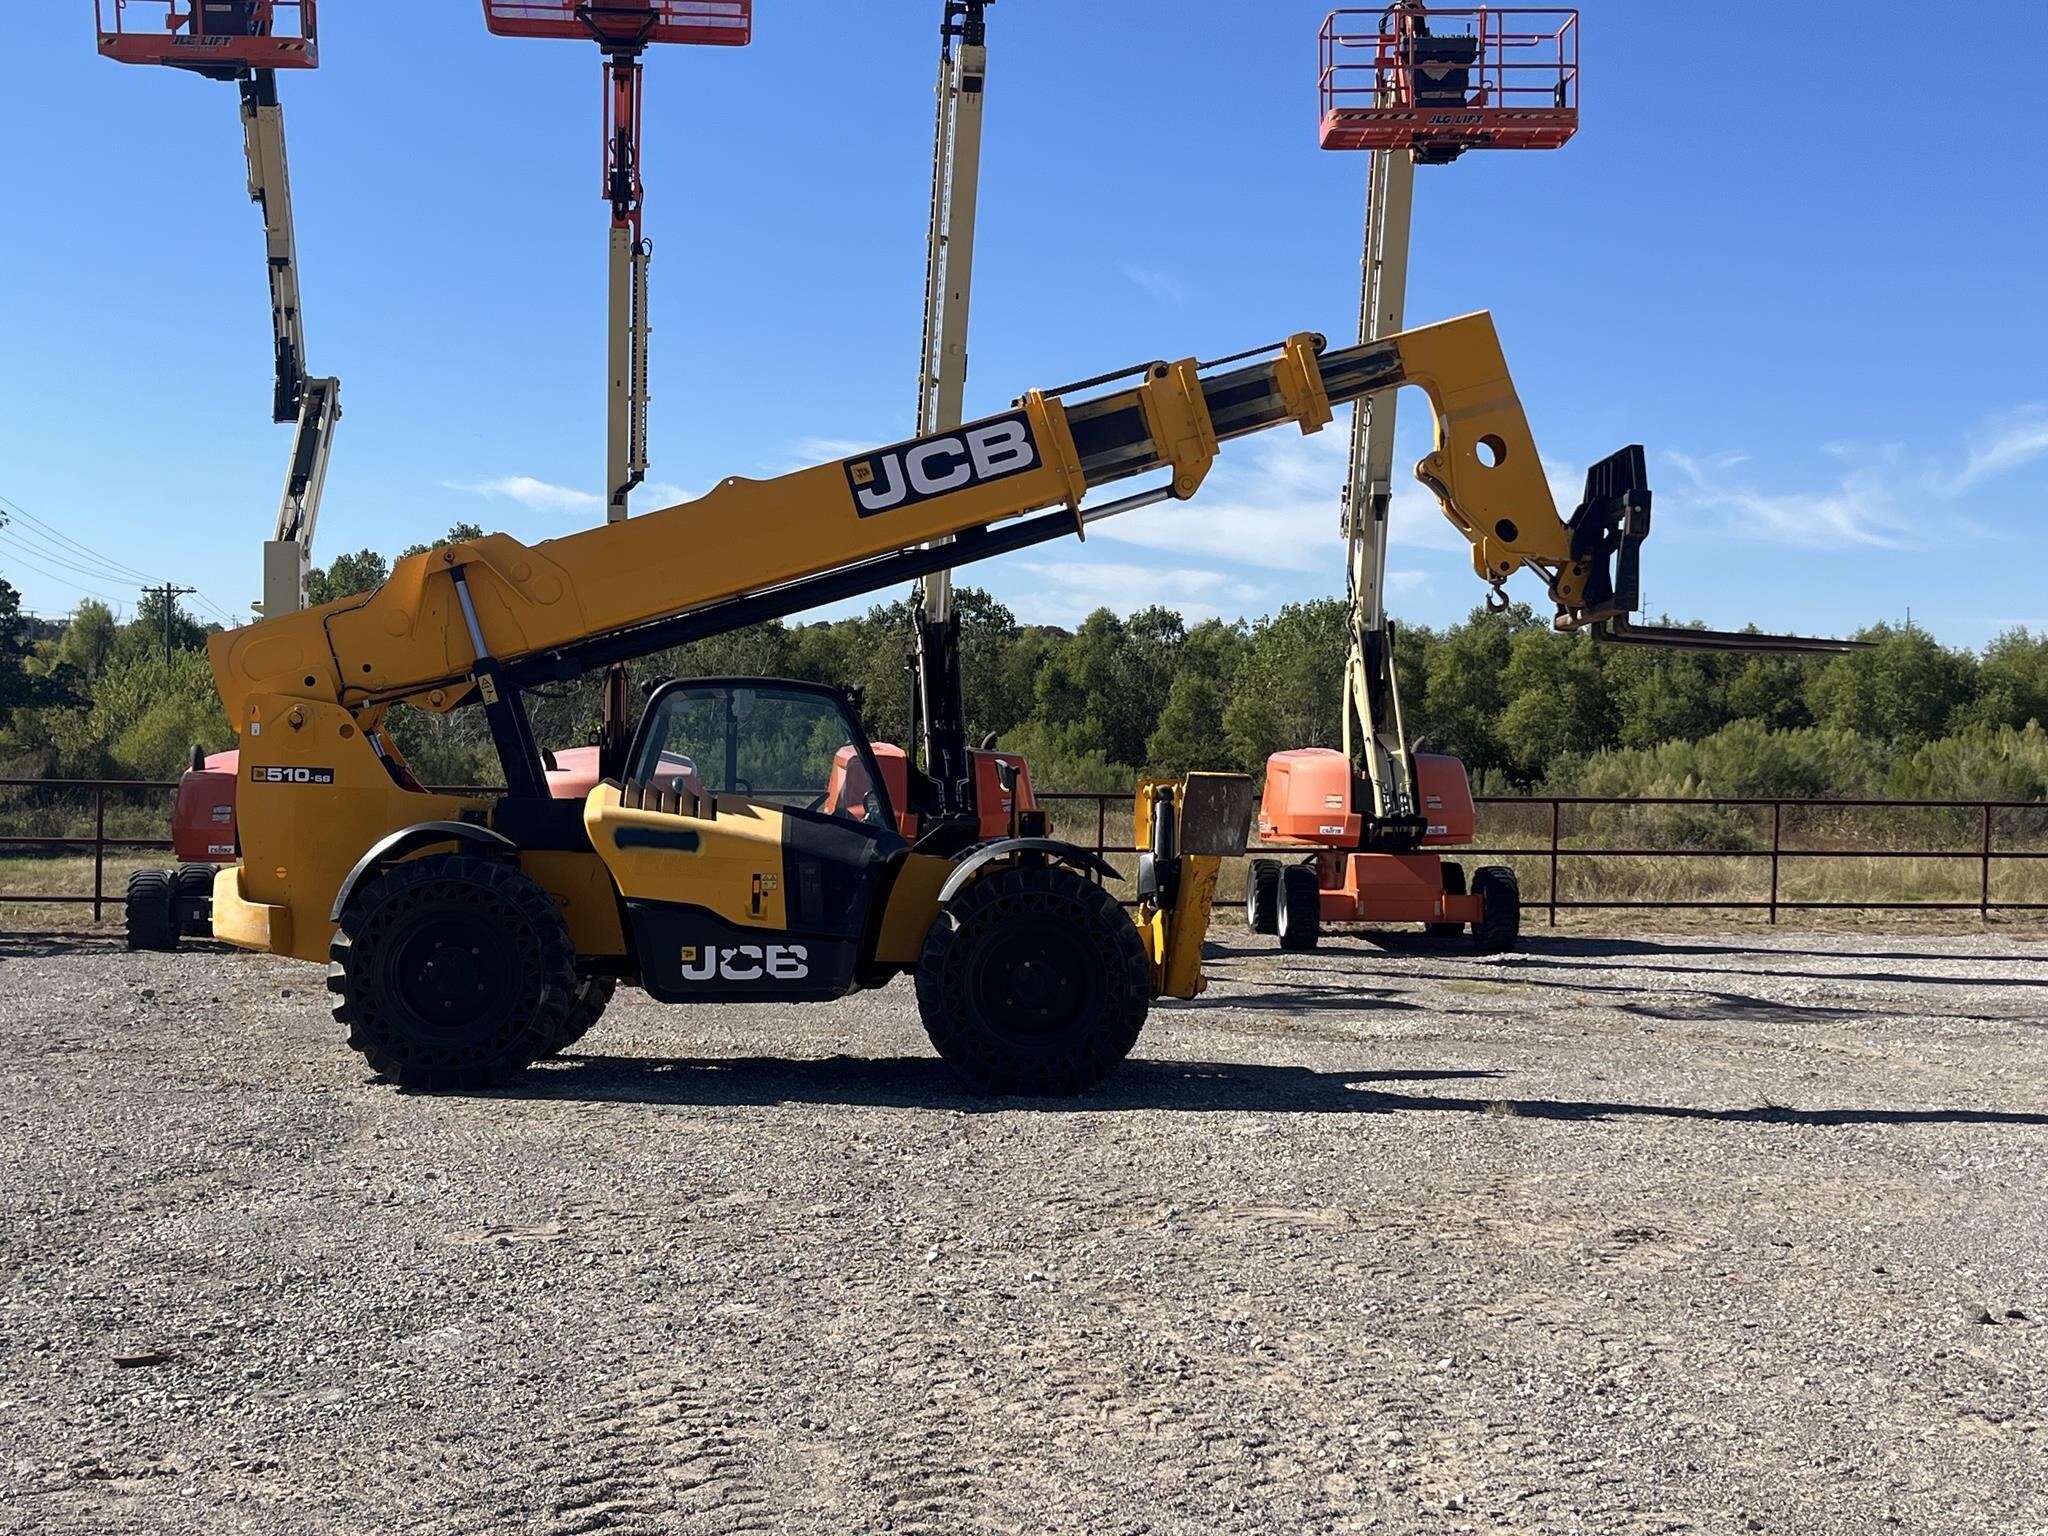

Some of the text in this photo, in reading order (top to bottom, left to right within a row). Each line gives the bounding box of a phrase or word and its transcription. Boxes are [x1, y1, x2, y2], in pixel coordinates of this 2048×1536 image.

[200, 35, 232, 47] LIFT
[1427, 113, 1484, 125] JLG LIFT
[857, 420, 1034, 510] JCB
[681, 945, 809, 981] JCB
